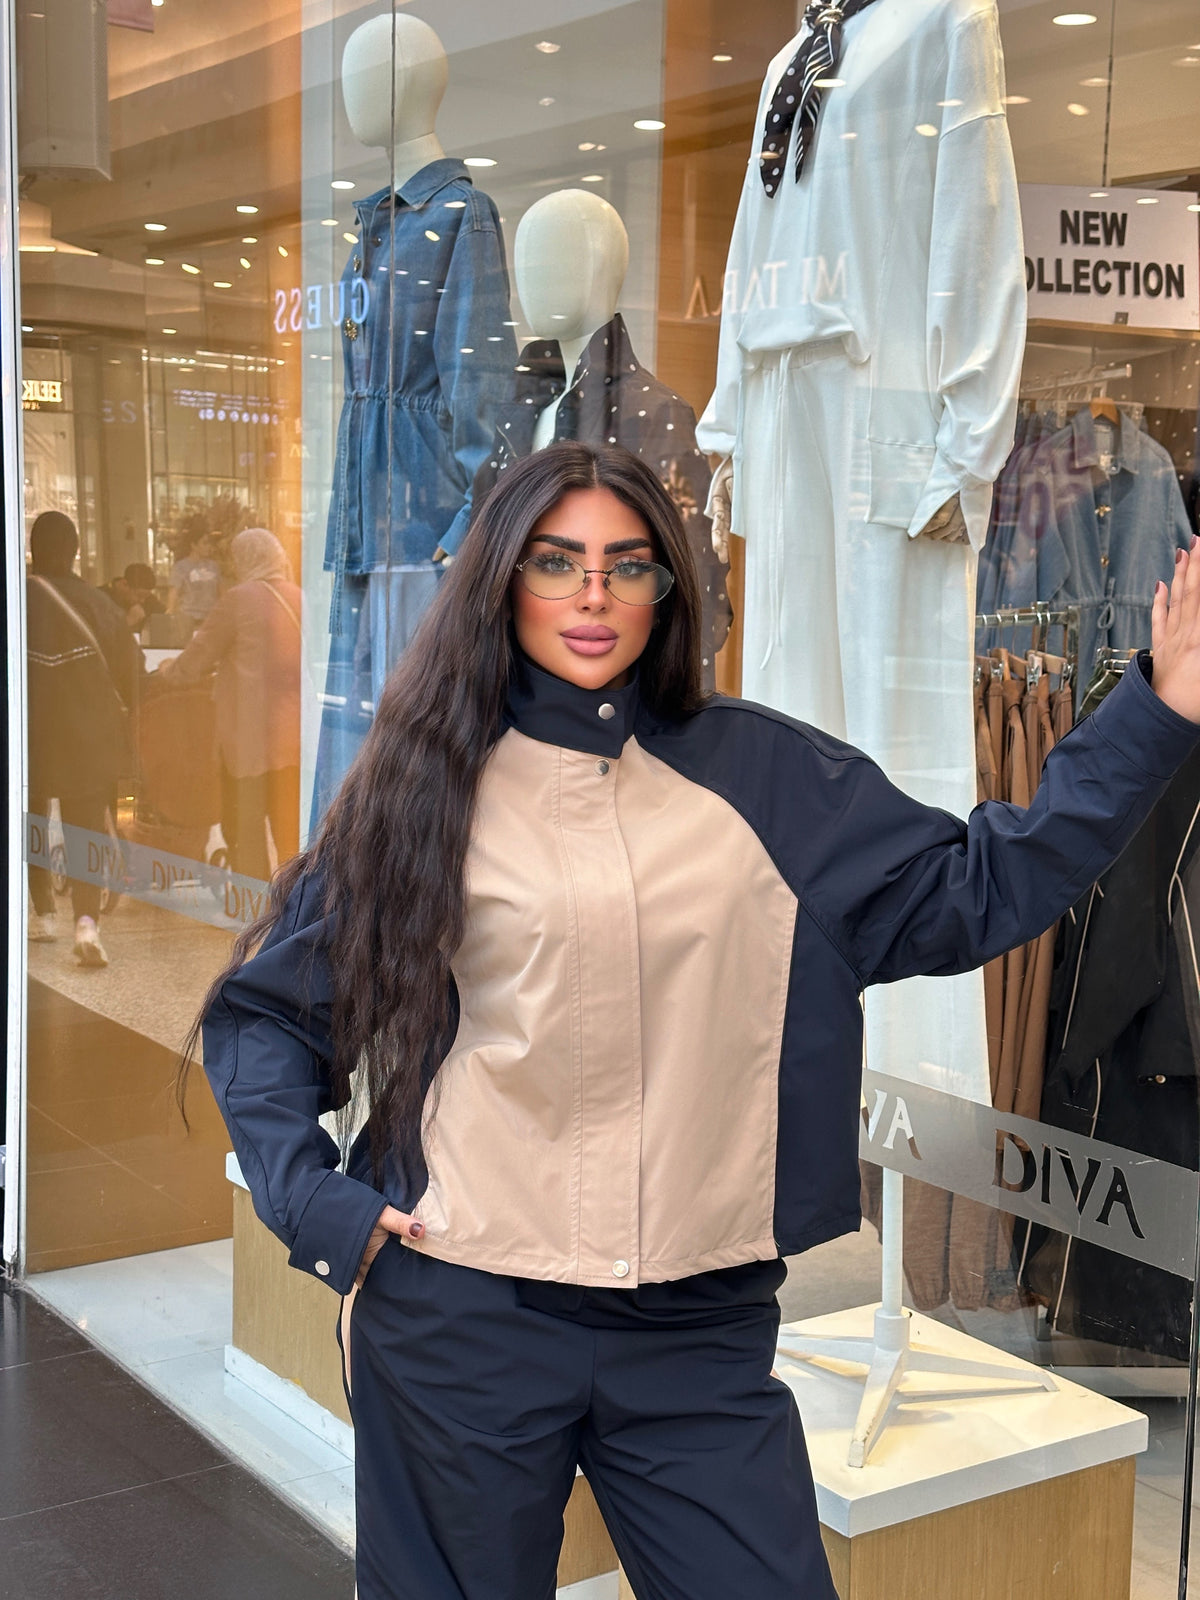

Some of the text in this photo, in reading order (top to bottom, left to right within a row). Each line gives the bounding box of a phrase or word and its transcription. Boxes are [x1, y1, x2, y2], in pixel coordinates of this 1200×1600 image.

[1060, 209, 1128, 247] NEW
[1025, 256, 1185, 299] OLLECTION
[861, 1089, 1146, 1240] VA DIVA
